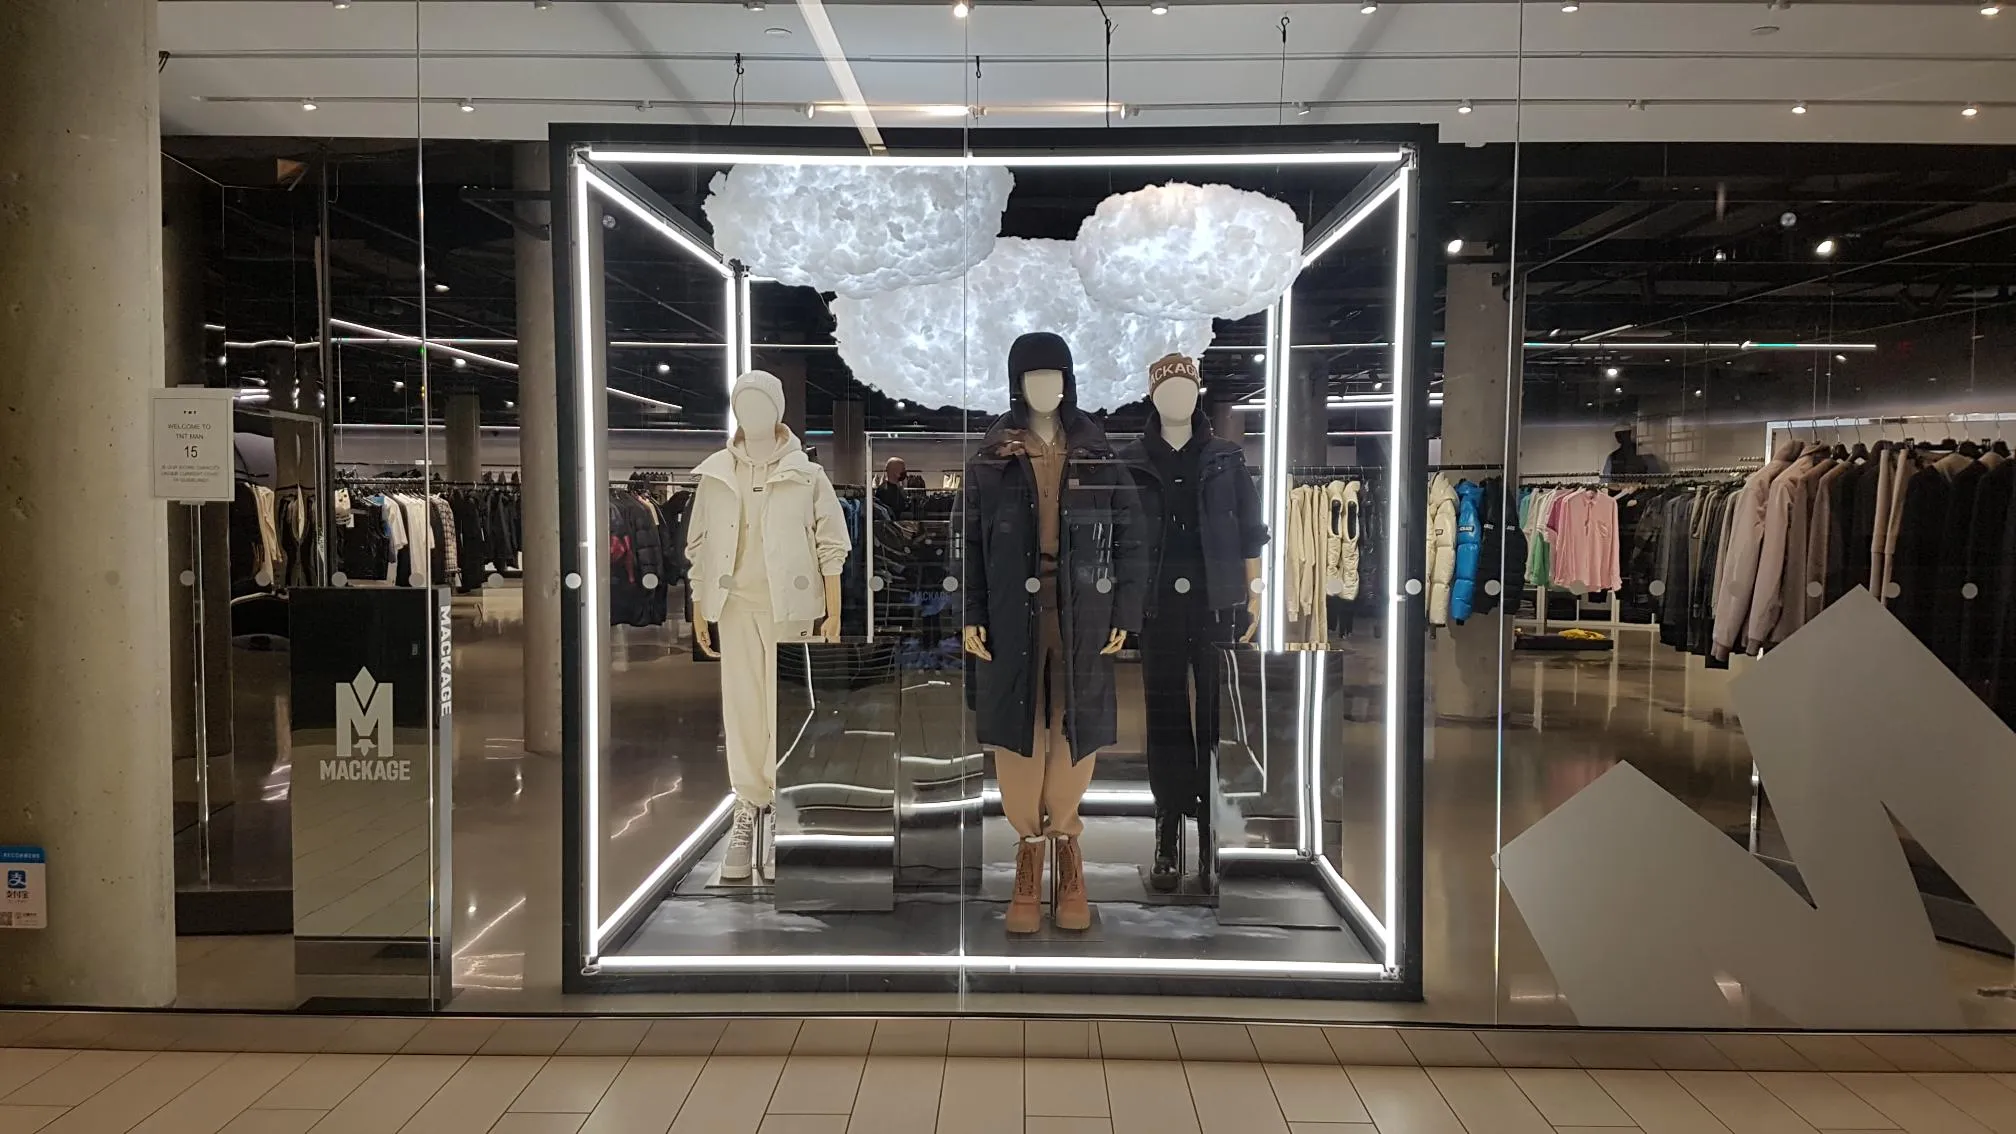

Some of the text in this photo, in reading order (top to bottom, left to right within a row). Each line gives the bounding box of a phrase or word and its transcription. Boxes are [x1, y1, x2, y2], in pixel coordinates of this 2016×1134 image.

[184, 445, 198, 458] 15
[440, 605, 452, 717] MACKAGE
[319, 759, 411, 781] MACKAGE
